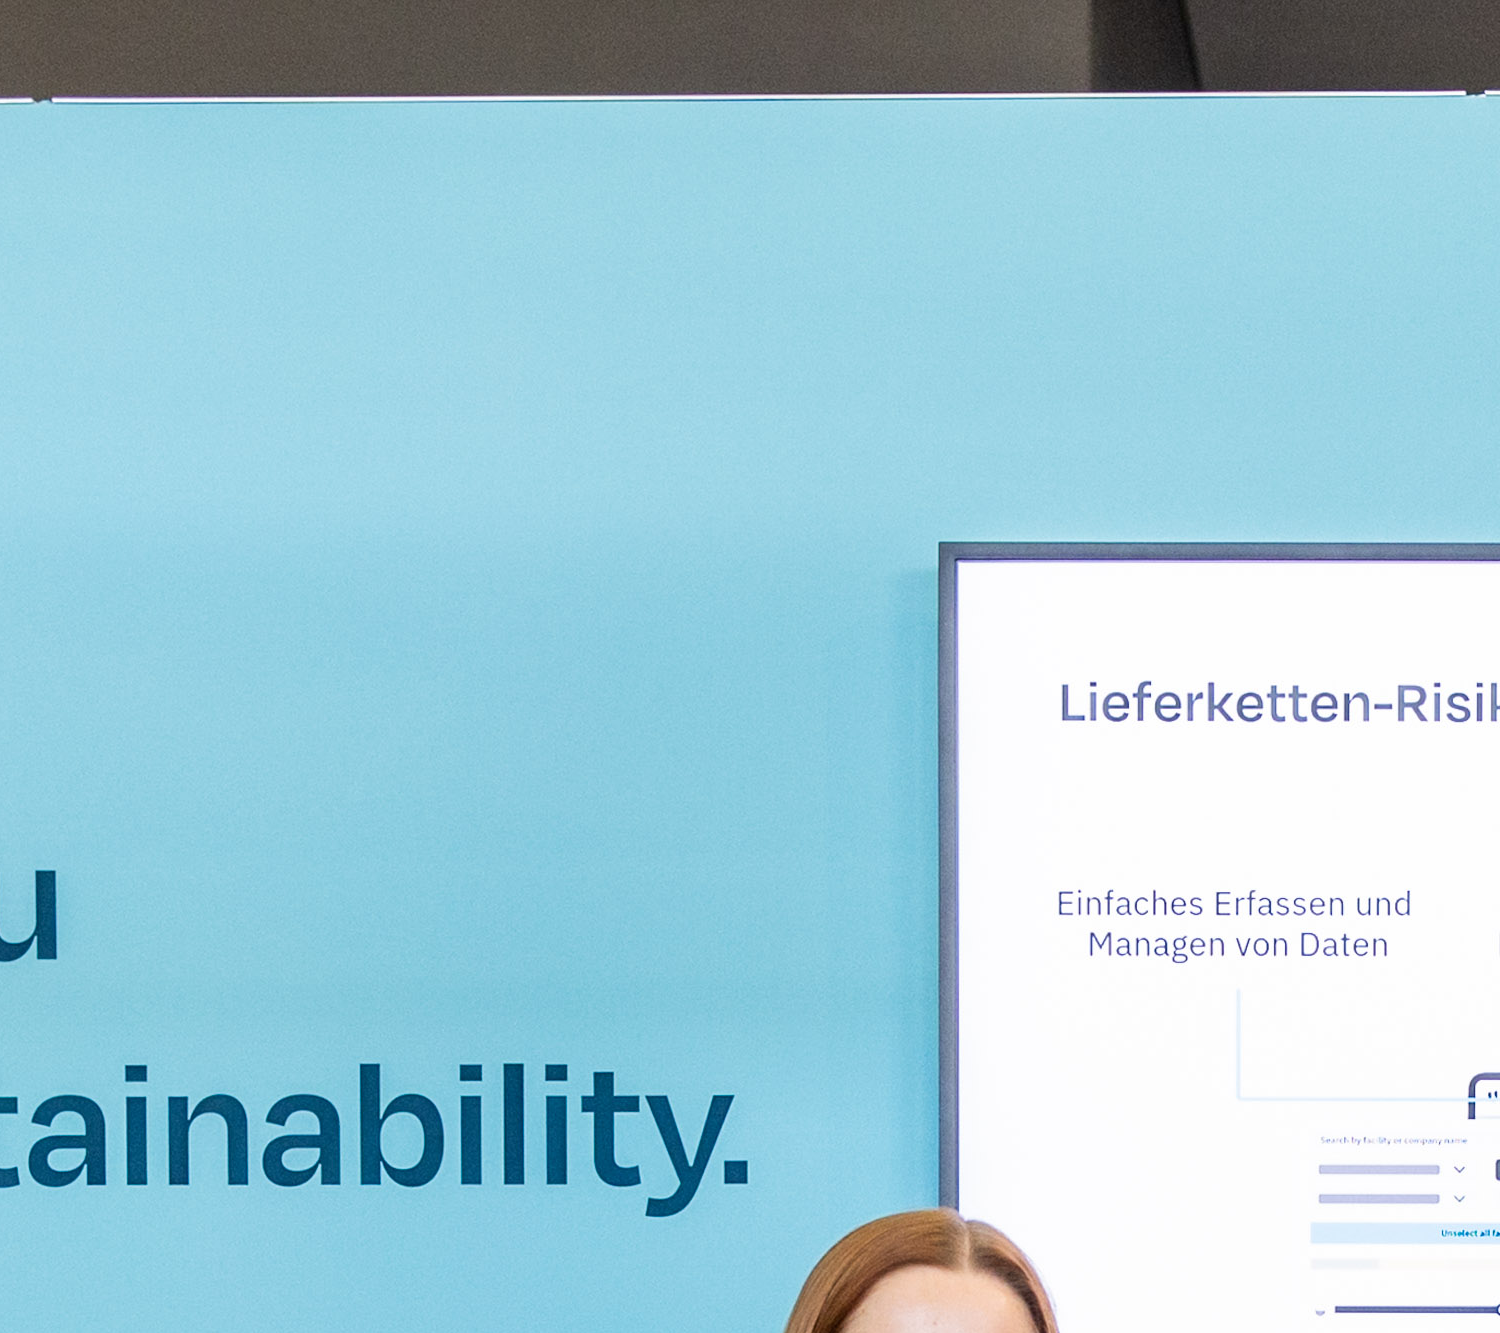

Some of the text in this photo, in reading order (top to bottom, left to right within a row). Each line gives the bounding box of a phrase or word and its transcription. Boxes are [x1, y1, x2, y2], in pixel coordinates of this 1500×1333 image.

[1059, 890, 1410, 916] Einfaches Erfassen und
[1090, 932, 1387, 963] Managen von Daten
